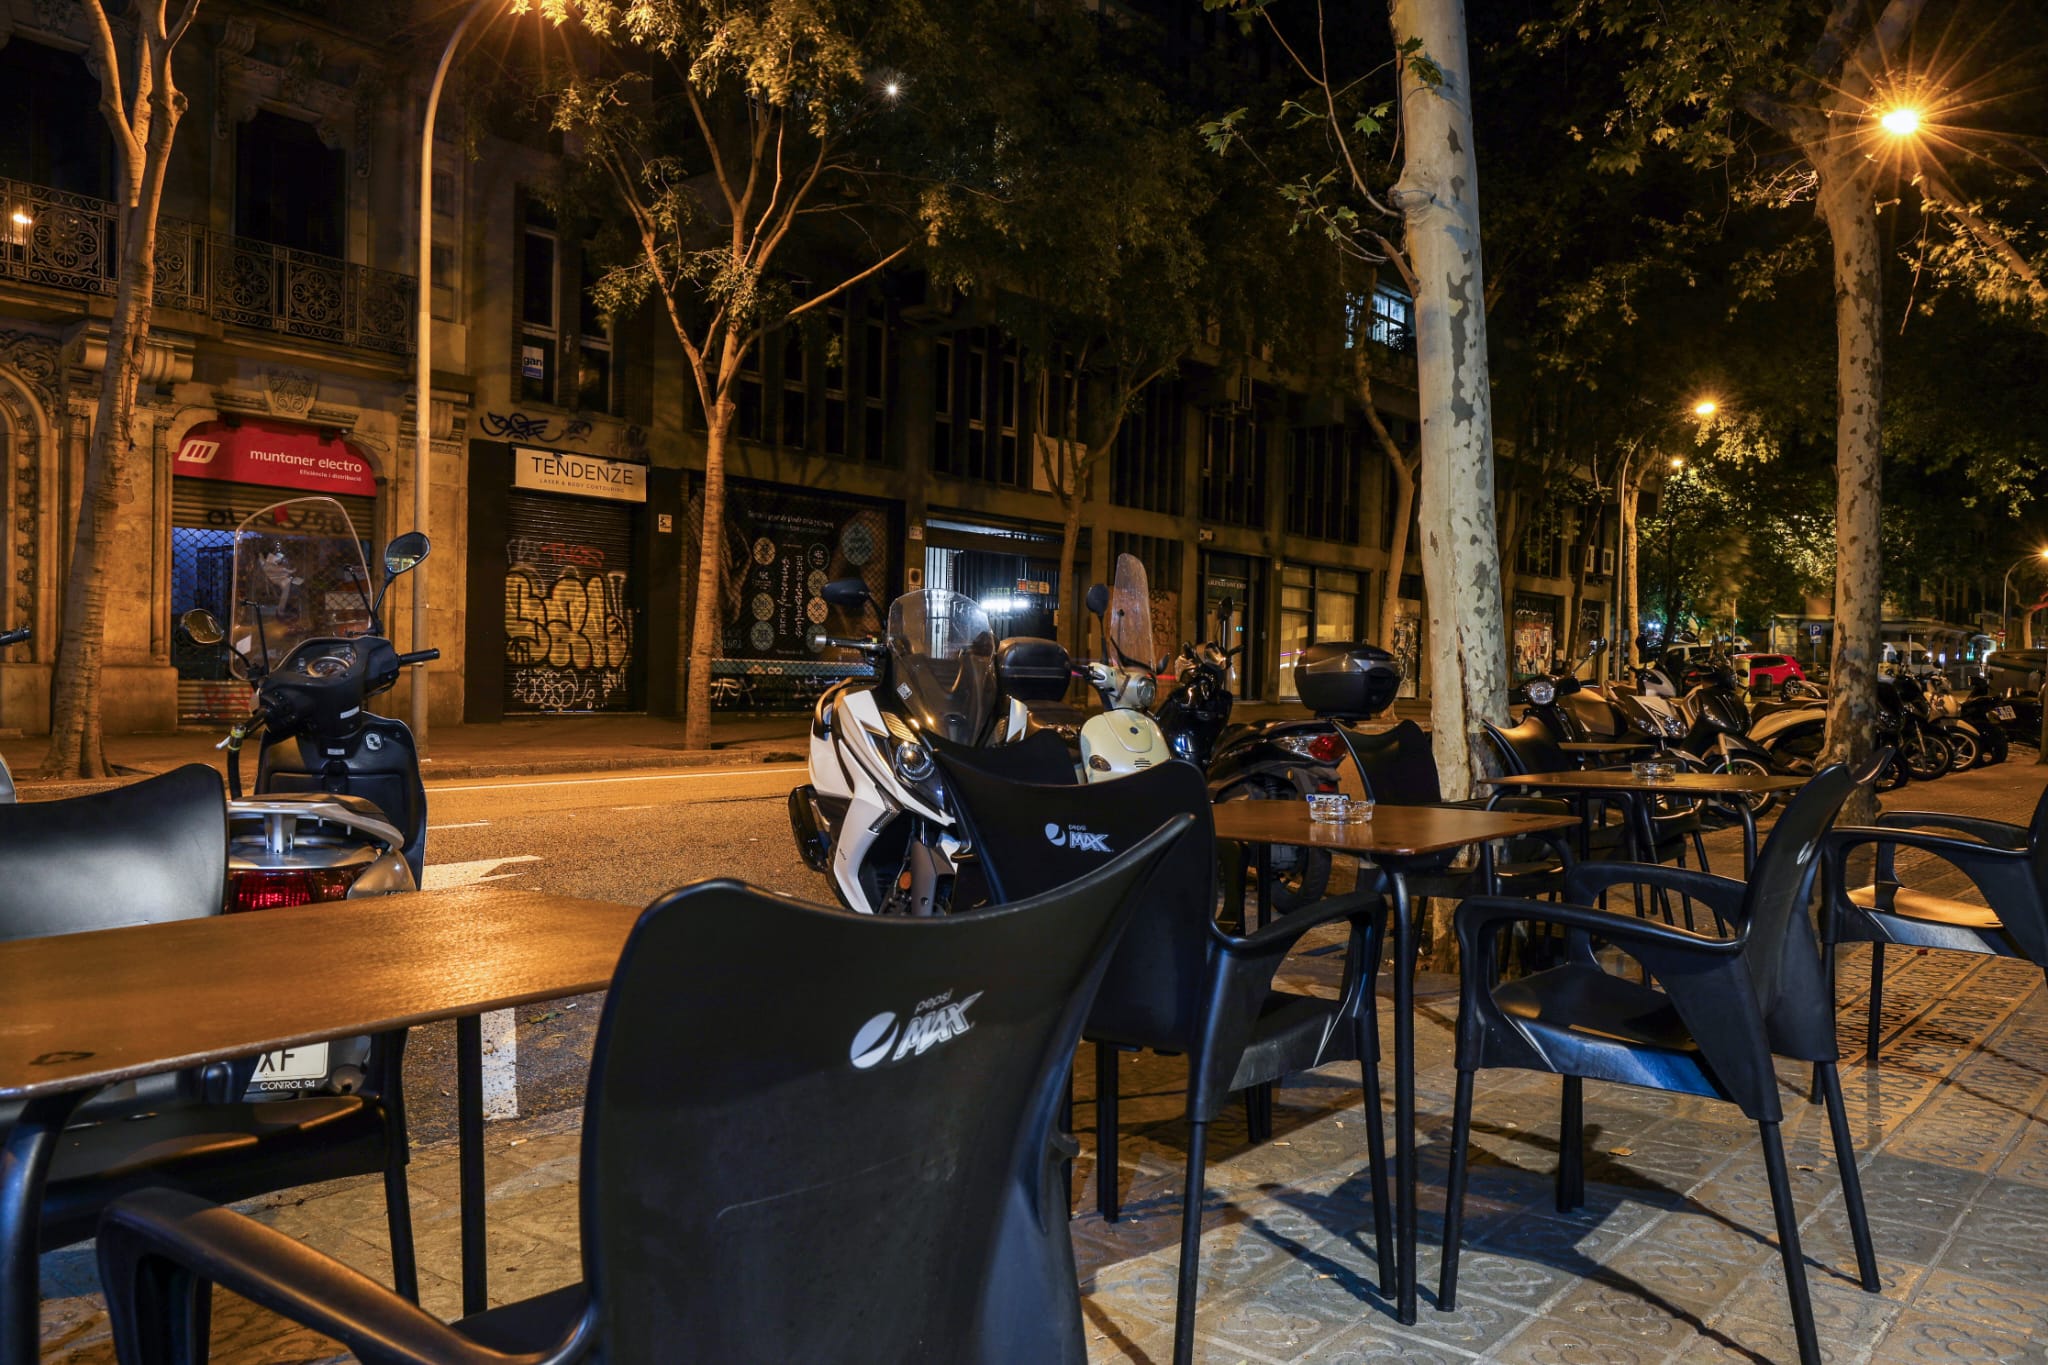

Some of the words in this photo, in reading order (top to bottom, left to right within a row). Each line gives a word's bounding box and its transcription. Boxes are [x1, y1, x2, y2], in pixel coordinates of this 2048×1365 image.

[250, 449, 316, 468] muntaner
[318, 457, 362, 473] electro
[531, 456, 634, 486] TENDENZE
[1069, 831, 1112, 852] MAX
[914, 988, 954, 1015] pepsi
[892, 990, 984, 1061] MAX
[260, 1080, 303, 1090] CONTROL
[304, 1080, 315, 1088] 94
